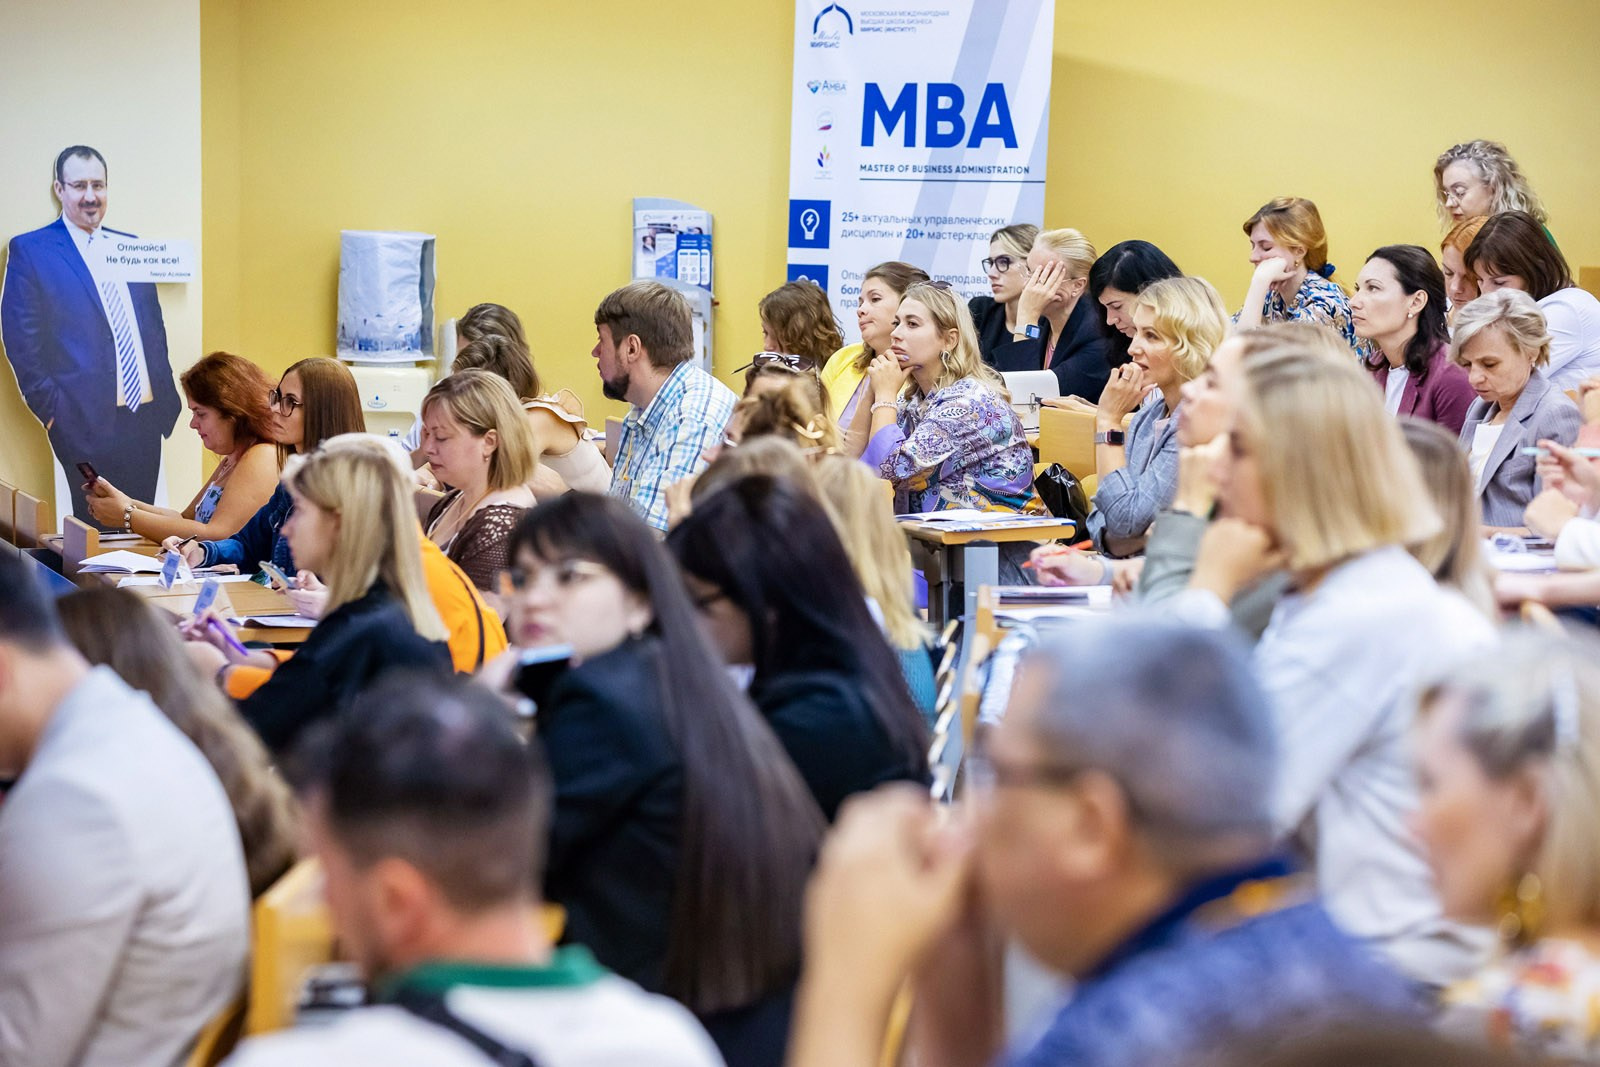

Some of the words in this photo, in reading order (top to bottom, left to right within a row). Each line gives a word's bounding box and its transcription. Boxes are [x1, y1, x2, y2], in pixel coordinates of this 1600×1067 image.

[860, 82, 1019, 149] MBA
[859, 164, 895, 173] MASTER
[897, 164, 910, 173] OF
[912, 164, 953, 174] BUSINESS
[955, 165, 1030, 175] ADMINISTRATION
[841, 211, 859, 223] 25+
[862, 214, 922, 225] актуальных
[924, 215, 1006, 227] управленческих
[841, 228, 894, 239] дисциплин
[905, 228, 925, 240] 20+
[927, 230, 991, 242] мастер-клас
[117, 243, 167, 252] Отличайся!
[106, 256, 118, 264] Не
[120, 255, 142, 266] будь
[161, 256, 180, 264] все!
[933, 274, 988, 285] преподава
[840, 283, 862, 295] бол
